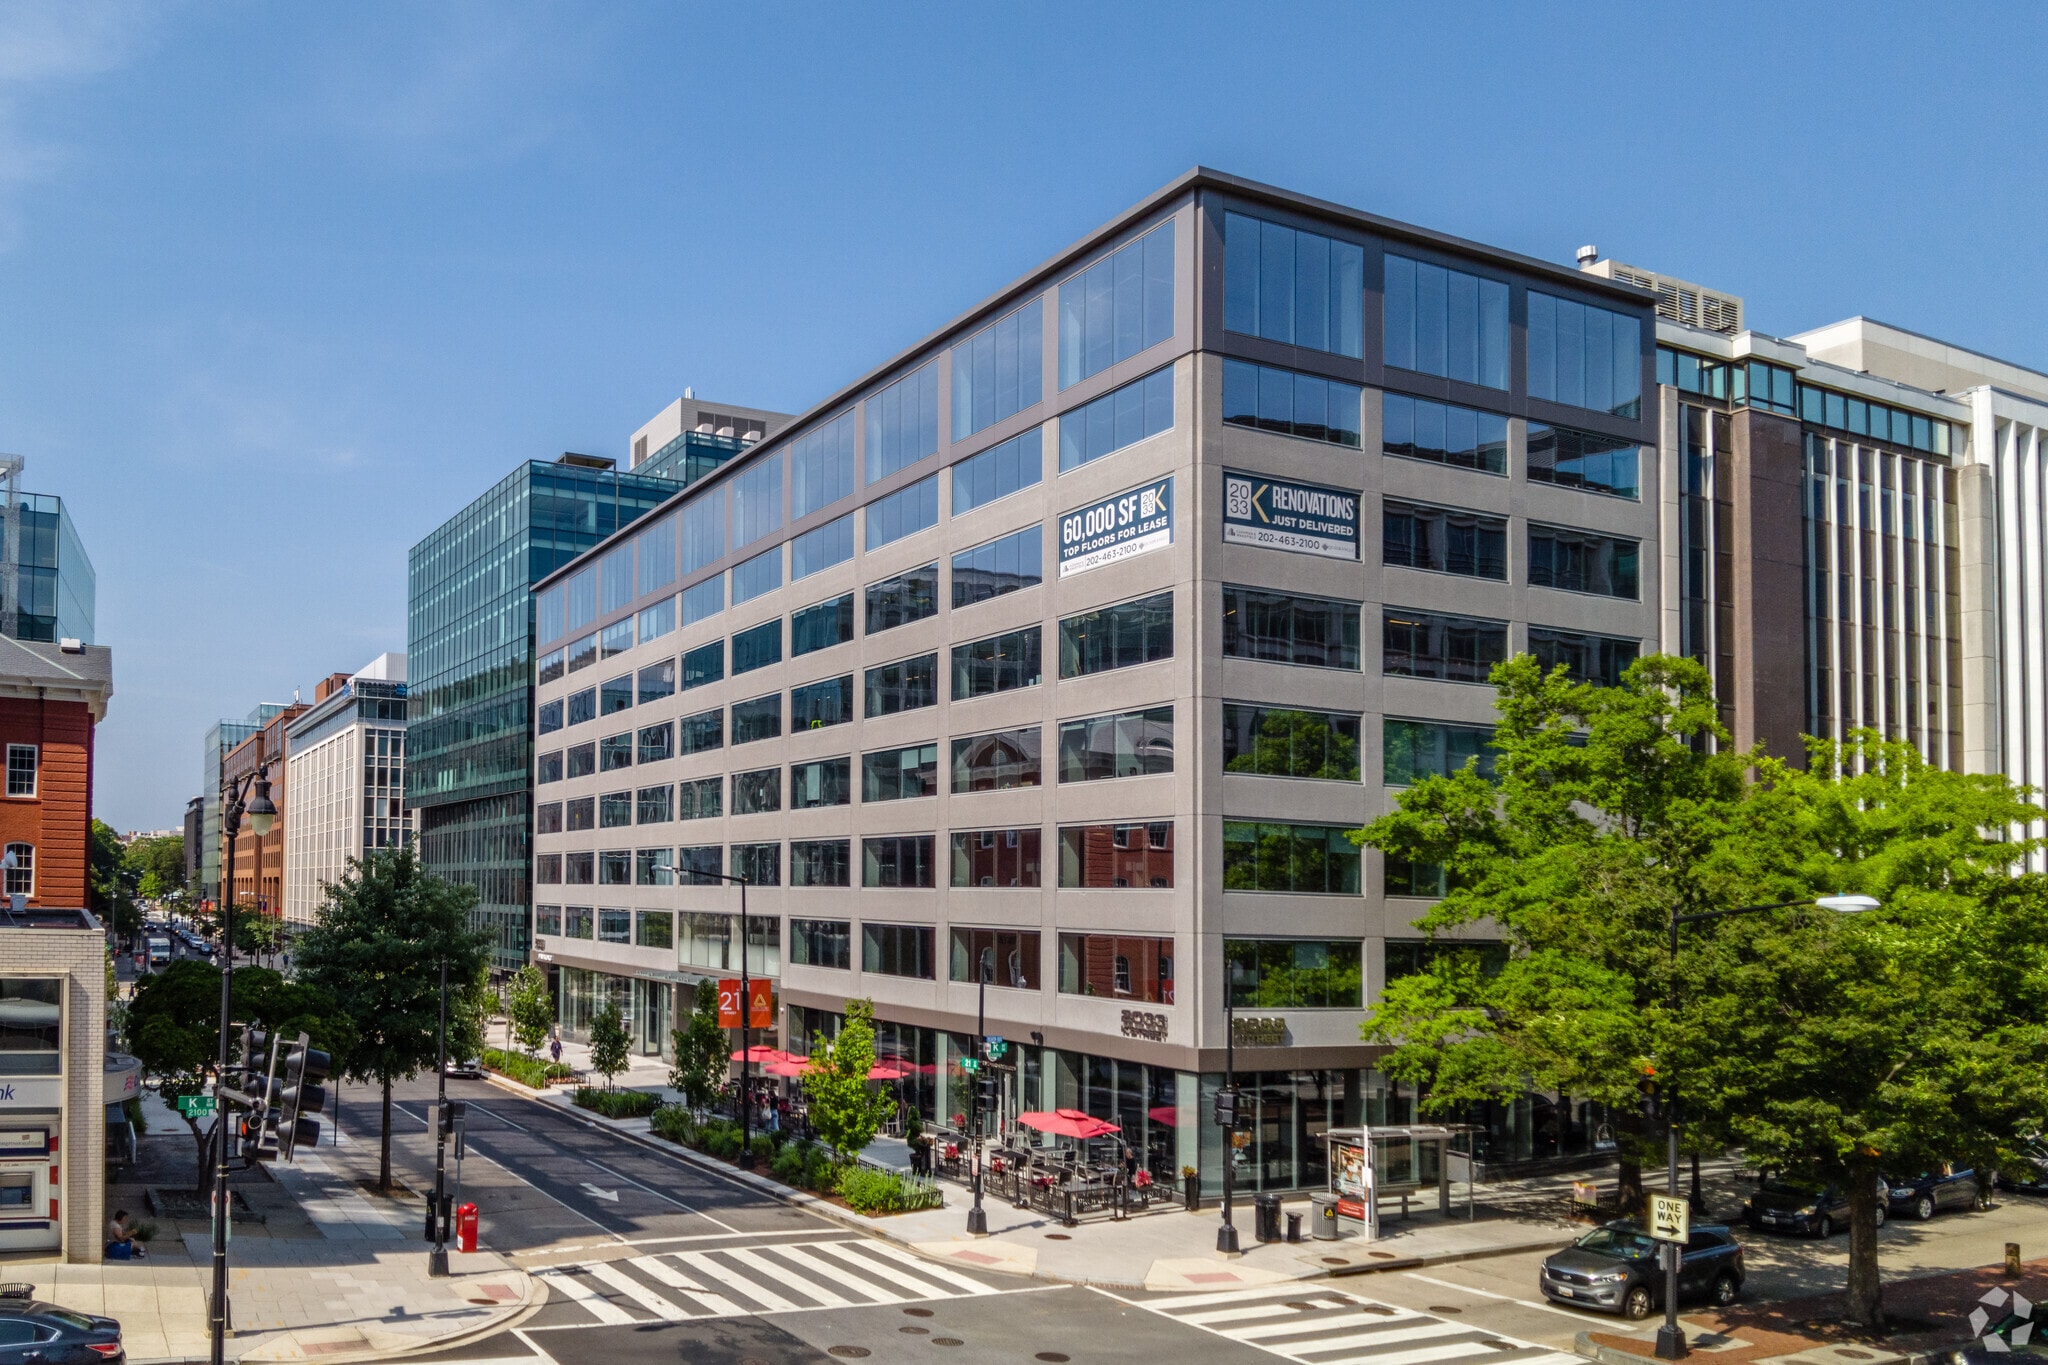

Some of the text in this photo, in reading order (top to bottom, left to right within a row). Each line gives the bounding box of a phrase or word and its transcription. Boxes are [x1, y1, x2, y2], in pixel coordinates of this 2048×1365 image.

[1142, 491, 1154, 505] 20
[1230, 483, 1249, 500] 20
[1142, 503, 1154, 515] 33
[1230, 499, 1249, 515] 33
[1272, 485, 1354, 521] RENOVATIONS
[1063, 494, 1138, 545] 60,000 SF
[1271, 514, 1354, 536] JUST DELIVERED
[1063, 545, 1080, 558] TOP
[1081, 533, 1116, 552] FLOORS
[1117, 526, 1136, 541] FOR
[1138, 516, 1168, 534] LEASE
[1258, 531, 1320, 550] 202-463-2100
[1086, 543, 1137, 567] 202-463-2100
[719, 991, 740, 1011] 21
[188, 1097, 198, 1108] K
[188, 1109, 208, 1117] 2100
[1658, 1200, 1682, 1213] ONE
[1657, 1211, 1682, 1224] WAY
